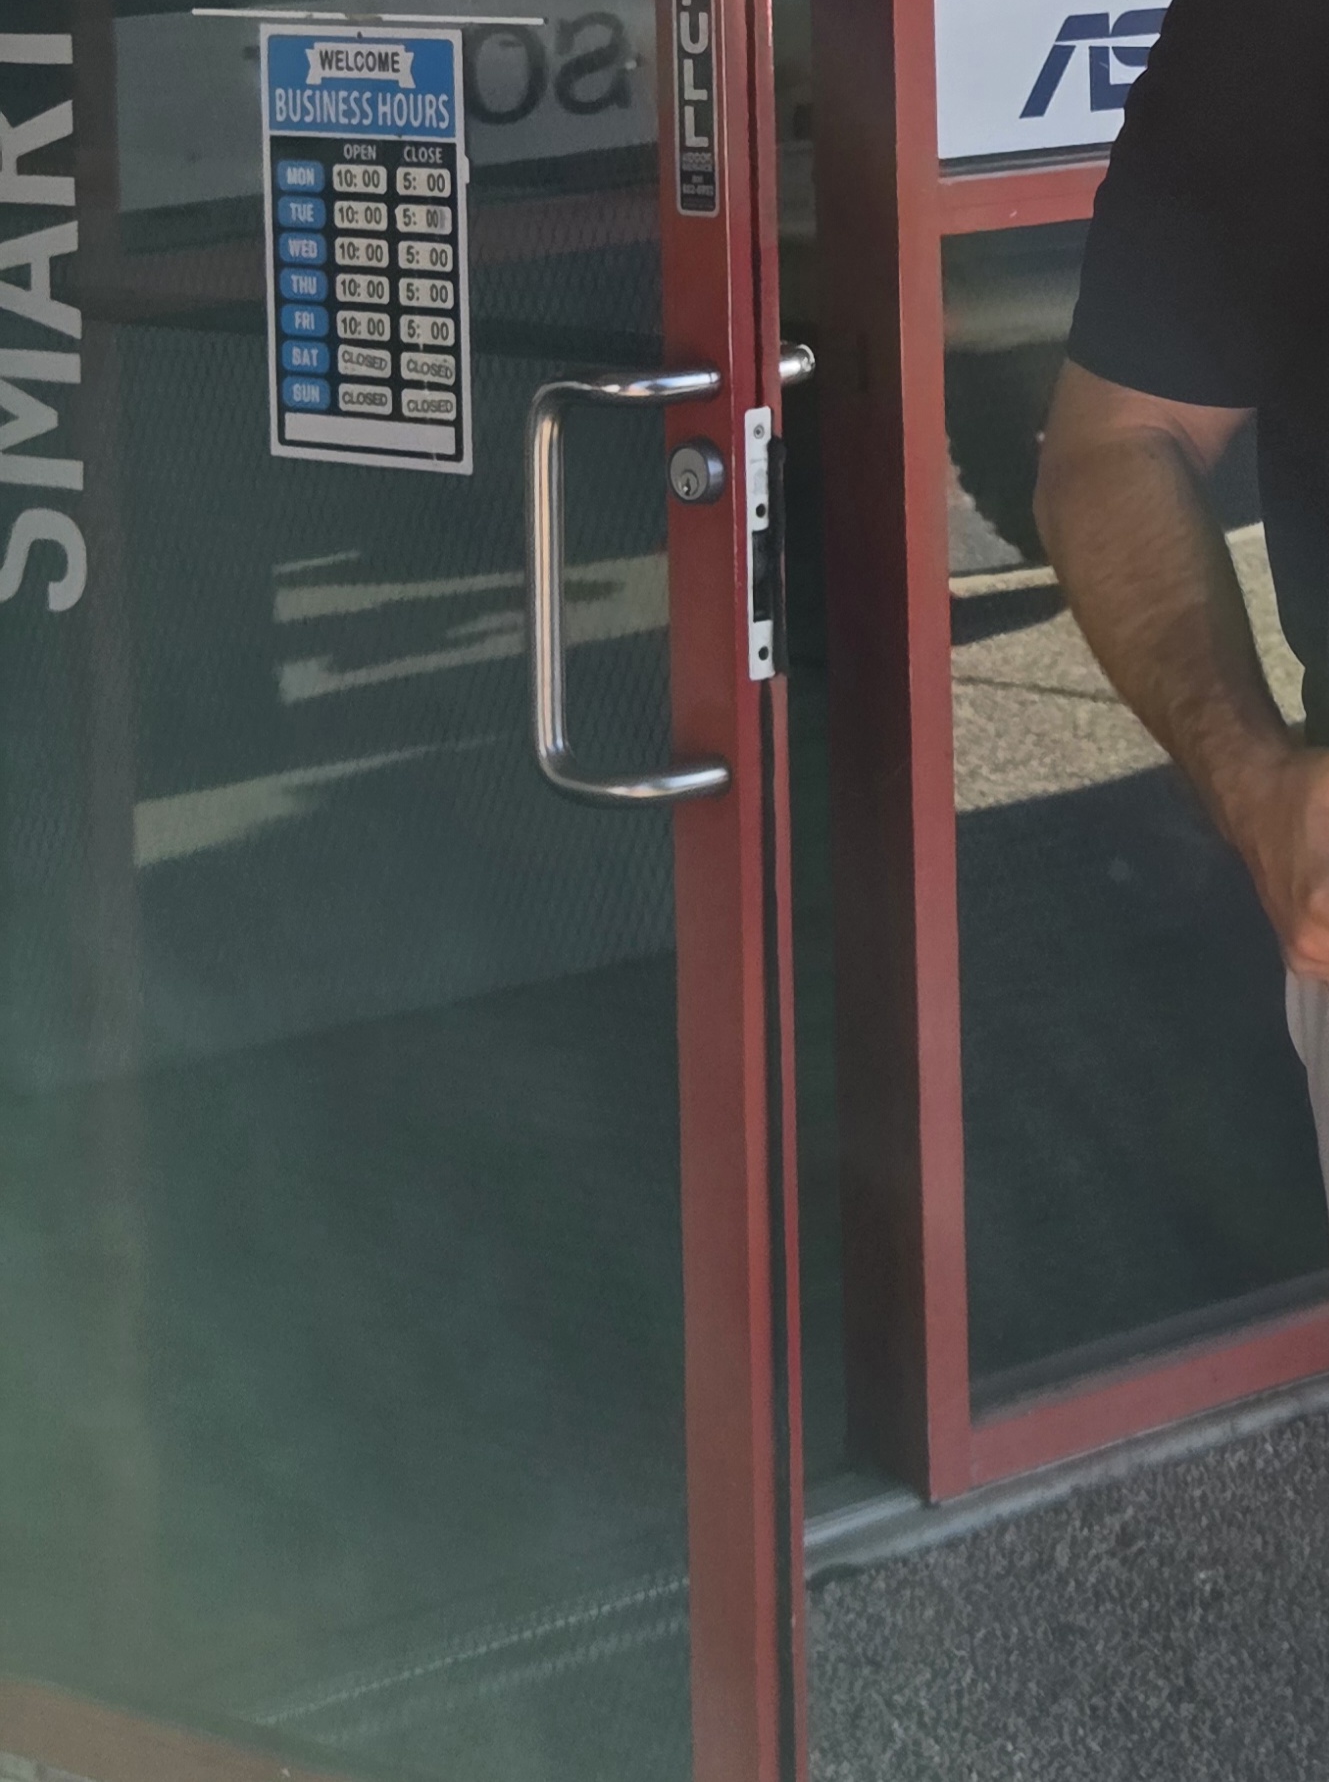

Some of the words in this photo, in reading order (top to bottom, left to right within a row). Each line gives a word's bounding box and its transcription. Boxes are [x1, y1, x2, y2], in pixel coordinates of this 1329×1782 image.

[319, 49, 401, 73] WELCOME
[274, 87, 373, 126] BUSINESS
[377, 92, 450, 129] HOURS
[343, 143, 377, 160] OPEN
[403, 146, 443, 164] CLOSE
[286, 165, 315, 185] MON
[289, 203, 314, 222] TUE
[287, 238, 318, 258] WED
[290, 274, 317, 295] THU
[294, 311, 315, 331] FRI
[341, 350, 388, 372] CLOSED
[406, 358, 453, 380] CLOSED
[341, 390, 388, 407] CLOSED
[406, 398, 453, 414] CLOSED
